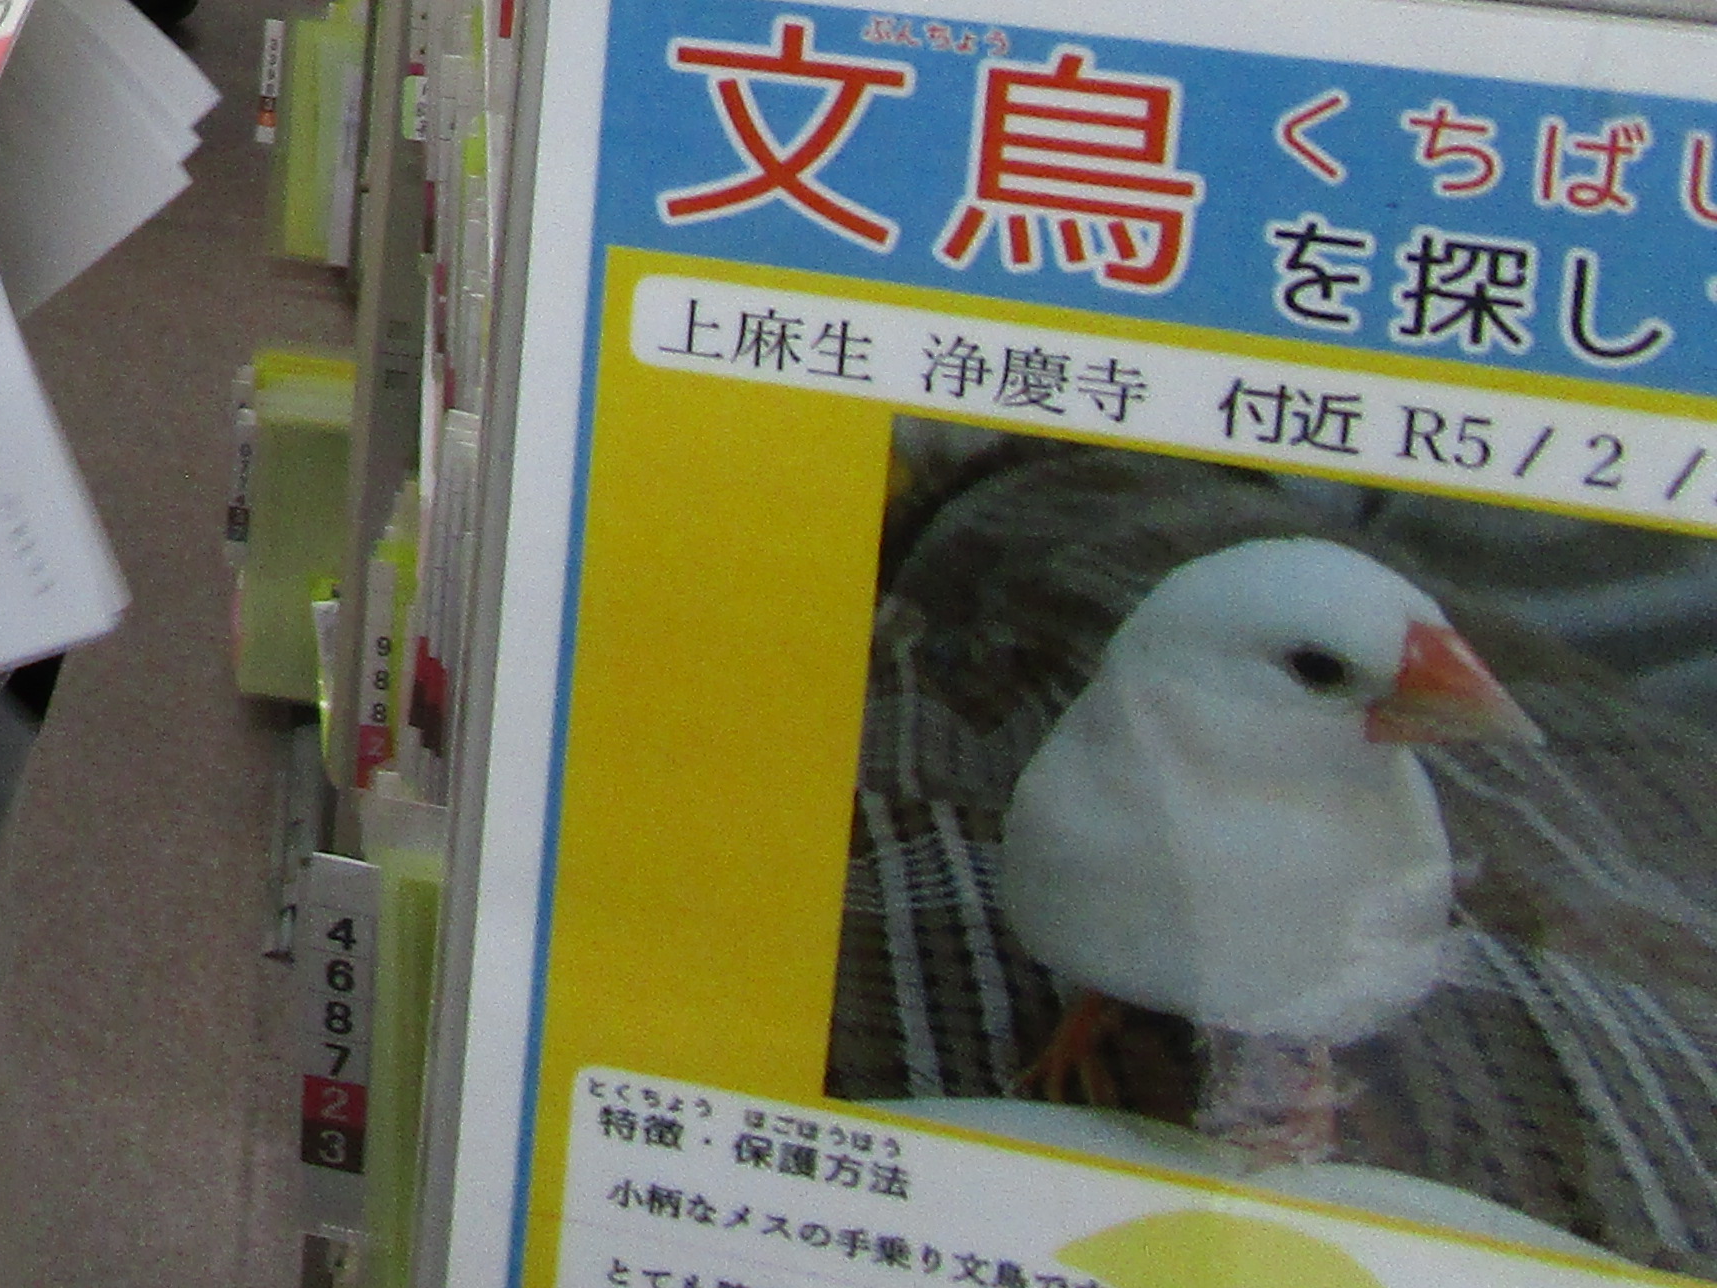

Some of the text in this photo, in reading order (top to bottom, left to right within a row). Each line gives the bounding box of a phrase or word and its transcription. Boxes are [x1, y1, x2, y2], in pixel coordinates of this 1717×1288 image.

[863, 16, 1008, 57] ぶんちょう
[663, 21, 1197, 289] 文鳥
[658, 299, 1717, 505] 上麻生 浄慶寺 付近 R5/2/
[589, 1077, 712, 1118] とくちょう
[606, 1177, 1108, 1288] 小柄なメスの手乗り文鳥
